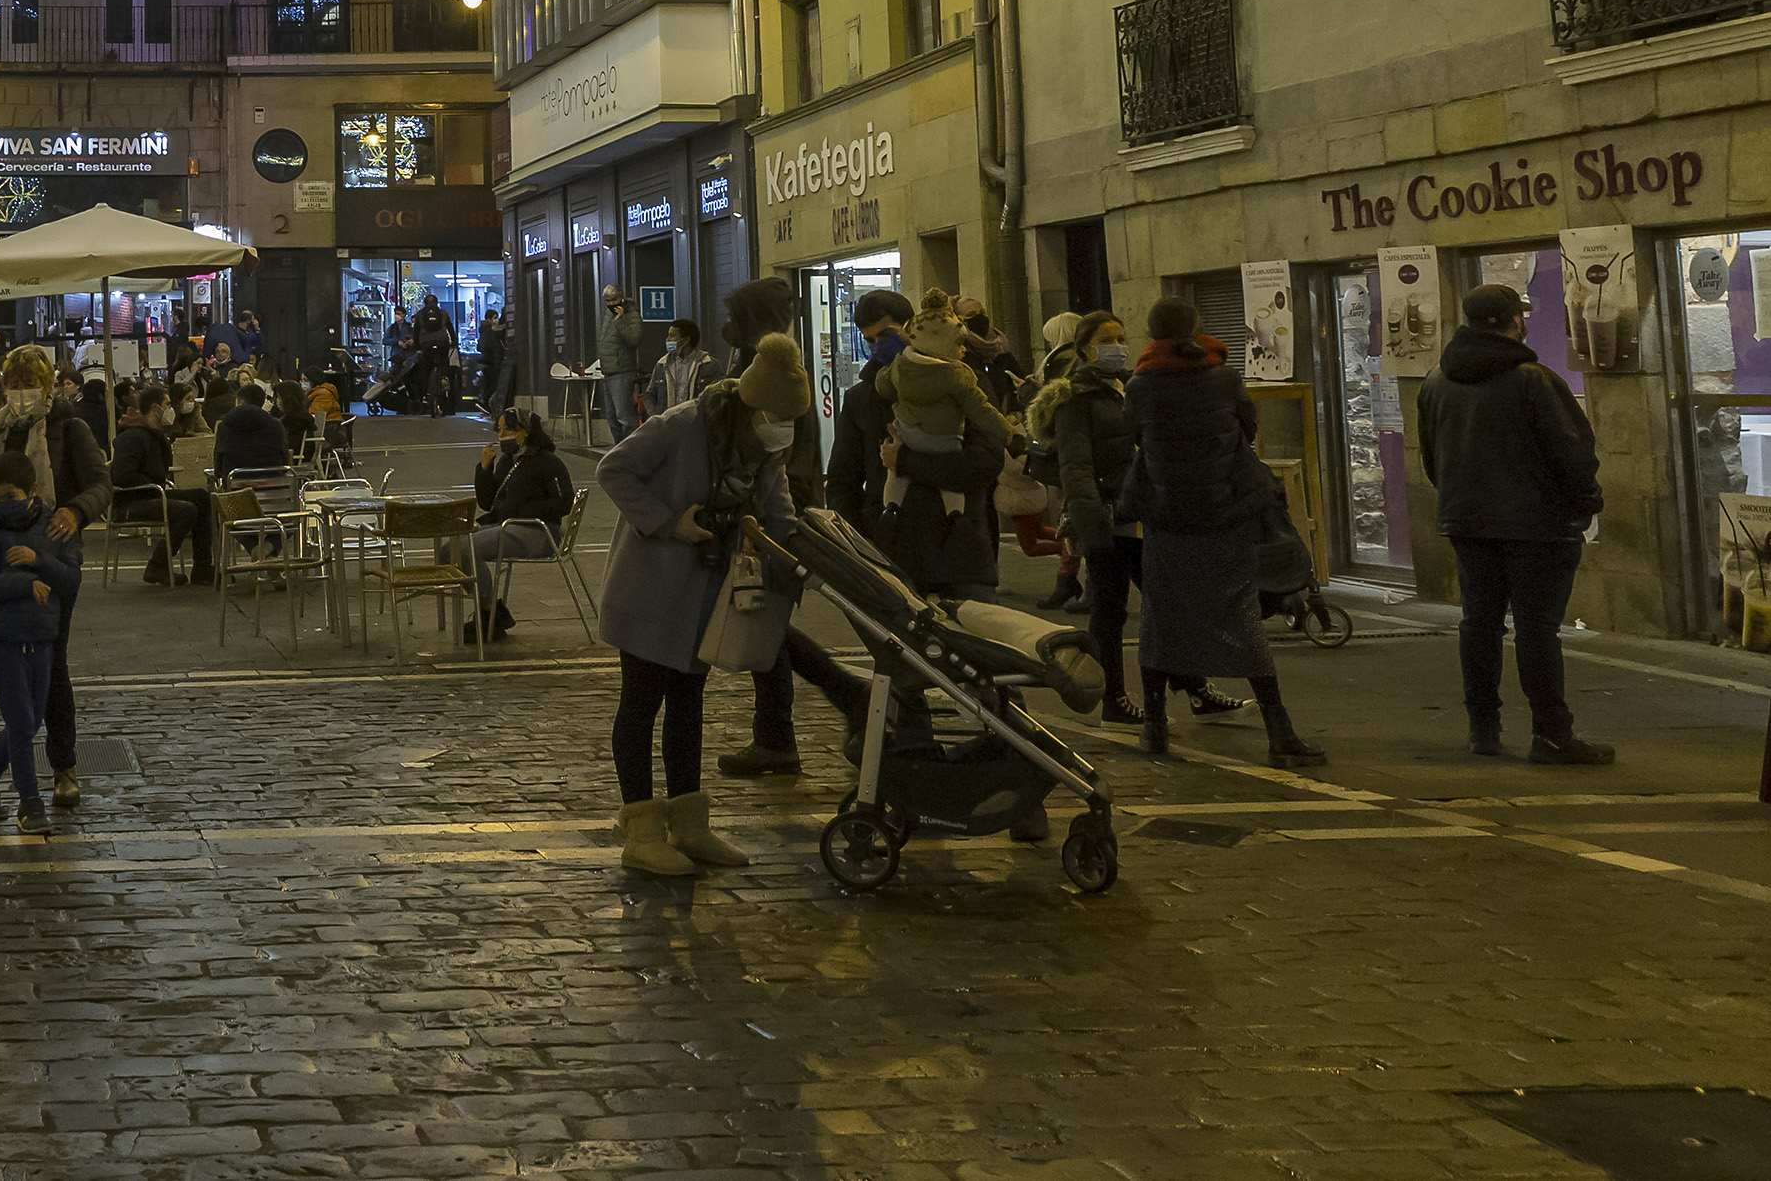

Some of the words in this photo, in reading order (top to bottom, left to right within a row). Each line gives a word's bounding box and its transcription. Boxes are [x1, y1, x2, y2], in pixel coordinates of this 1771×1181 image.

[40, 136, 83, 155] SAN
[88, 132, 168, 156] FERMÍN!
[76, 162, 152, 172] Restaurante
[765, 121, 895, 206] Kafetegia
[1321, 183, 1395, 233] The
[1406, 157, 1558, 222] Cookie
[1573, 143, 1703, 208] Shop
[274, 214, 289, 234] 2
[1700, 270, 1721, 281] Take
[650, 291, 666, 309] H
[820, 284, 833, 418] LIOS
